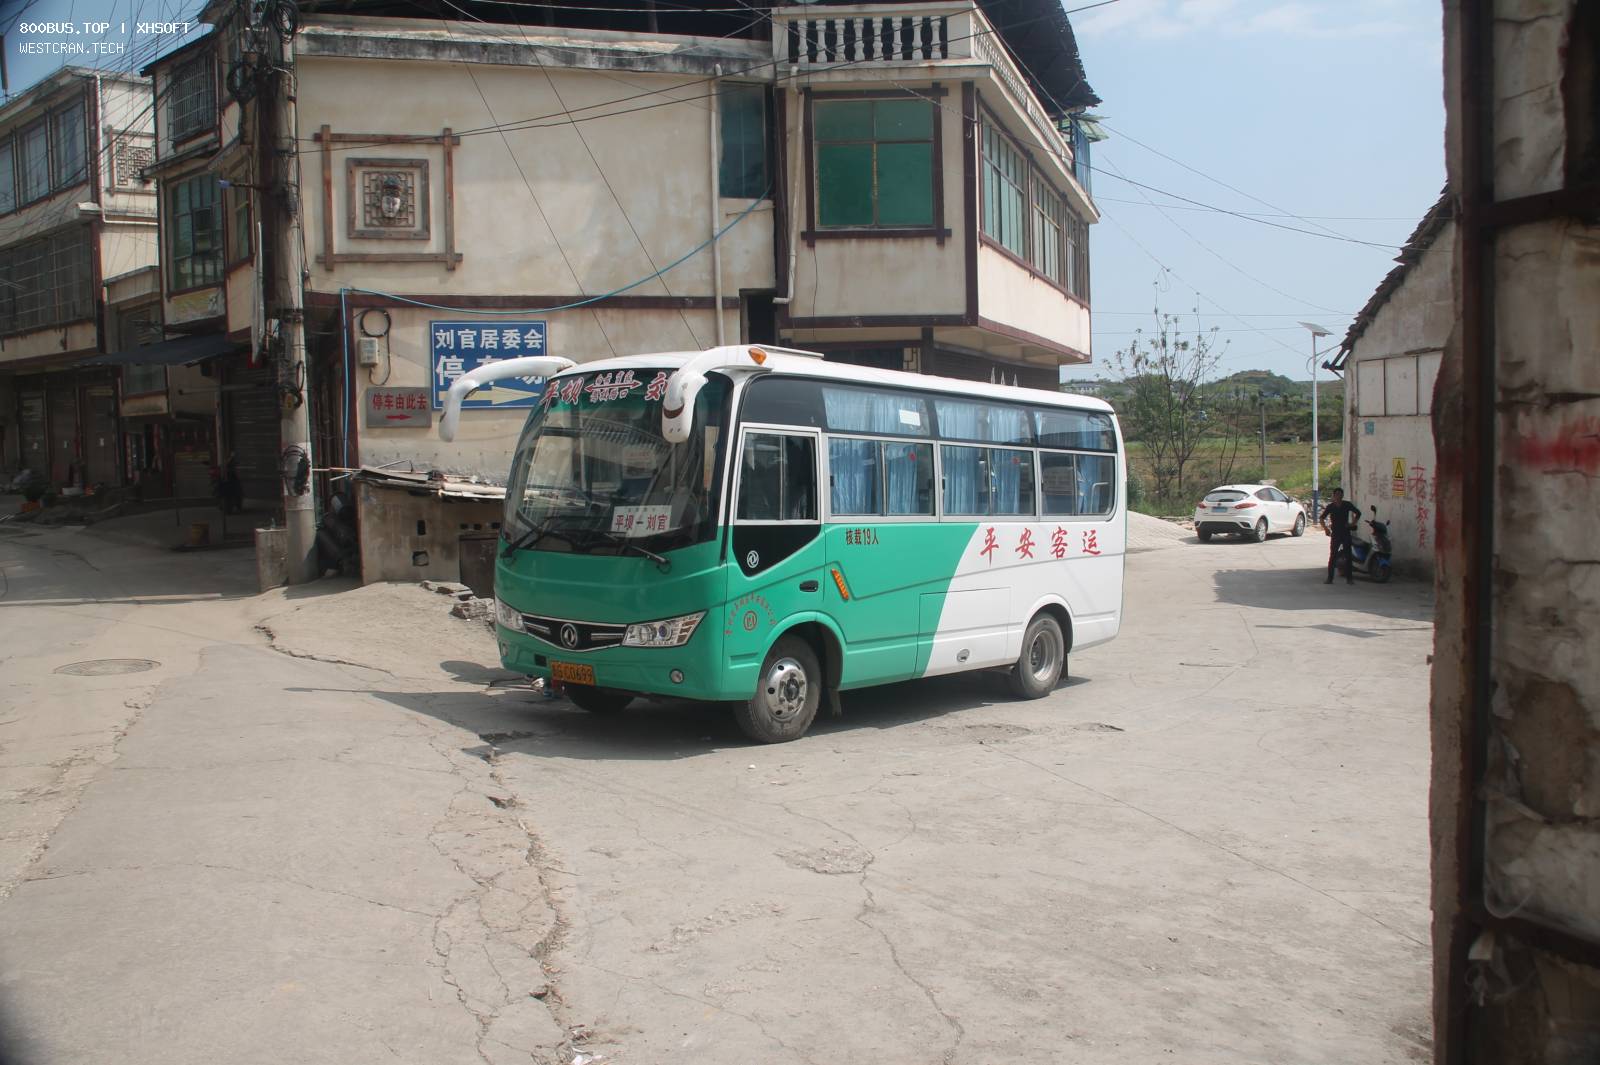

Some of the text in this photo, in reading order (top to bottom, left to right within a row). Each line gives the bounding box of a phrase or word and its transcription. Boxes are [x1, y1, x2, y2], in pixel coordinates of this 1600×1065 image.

[435, 328, 543, 350] 刘官居委会
[372, 393, 427, 411] 停车由此去
[845, 528, 879, 545] 核载19人
[980, 527, 1101, 565] 平安客运
